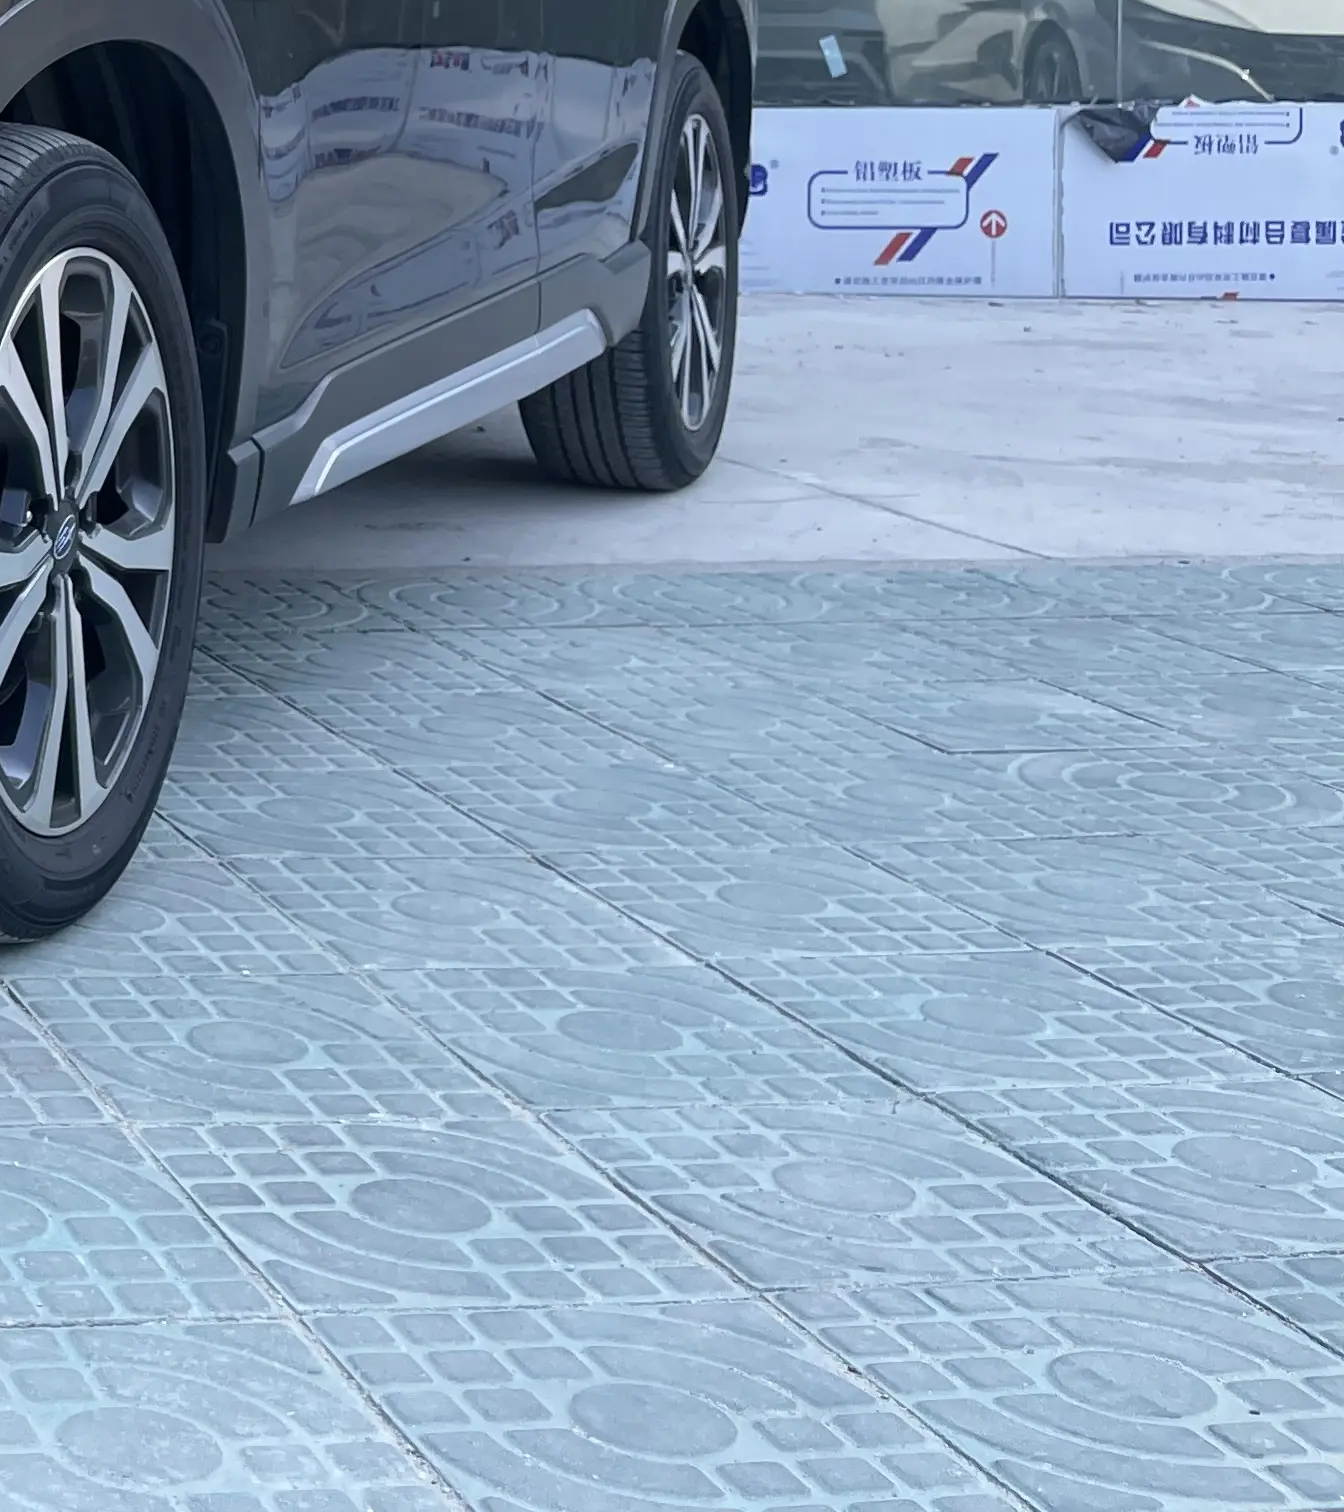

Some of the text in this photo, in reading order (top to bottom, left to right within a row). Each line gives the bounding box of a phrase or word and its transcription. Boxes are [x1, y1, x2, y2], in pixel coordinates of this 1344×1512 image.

[1109, 220, 1344, 246] 属复合材料有限公司
